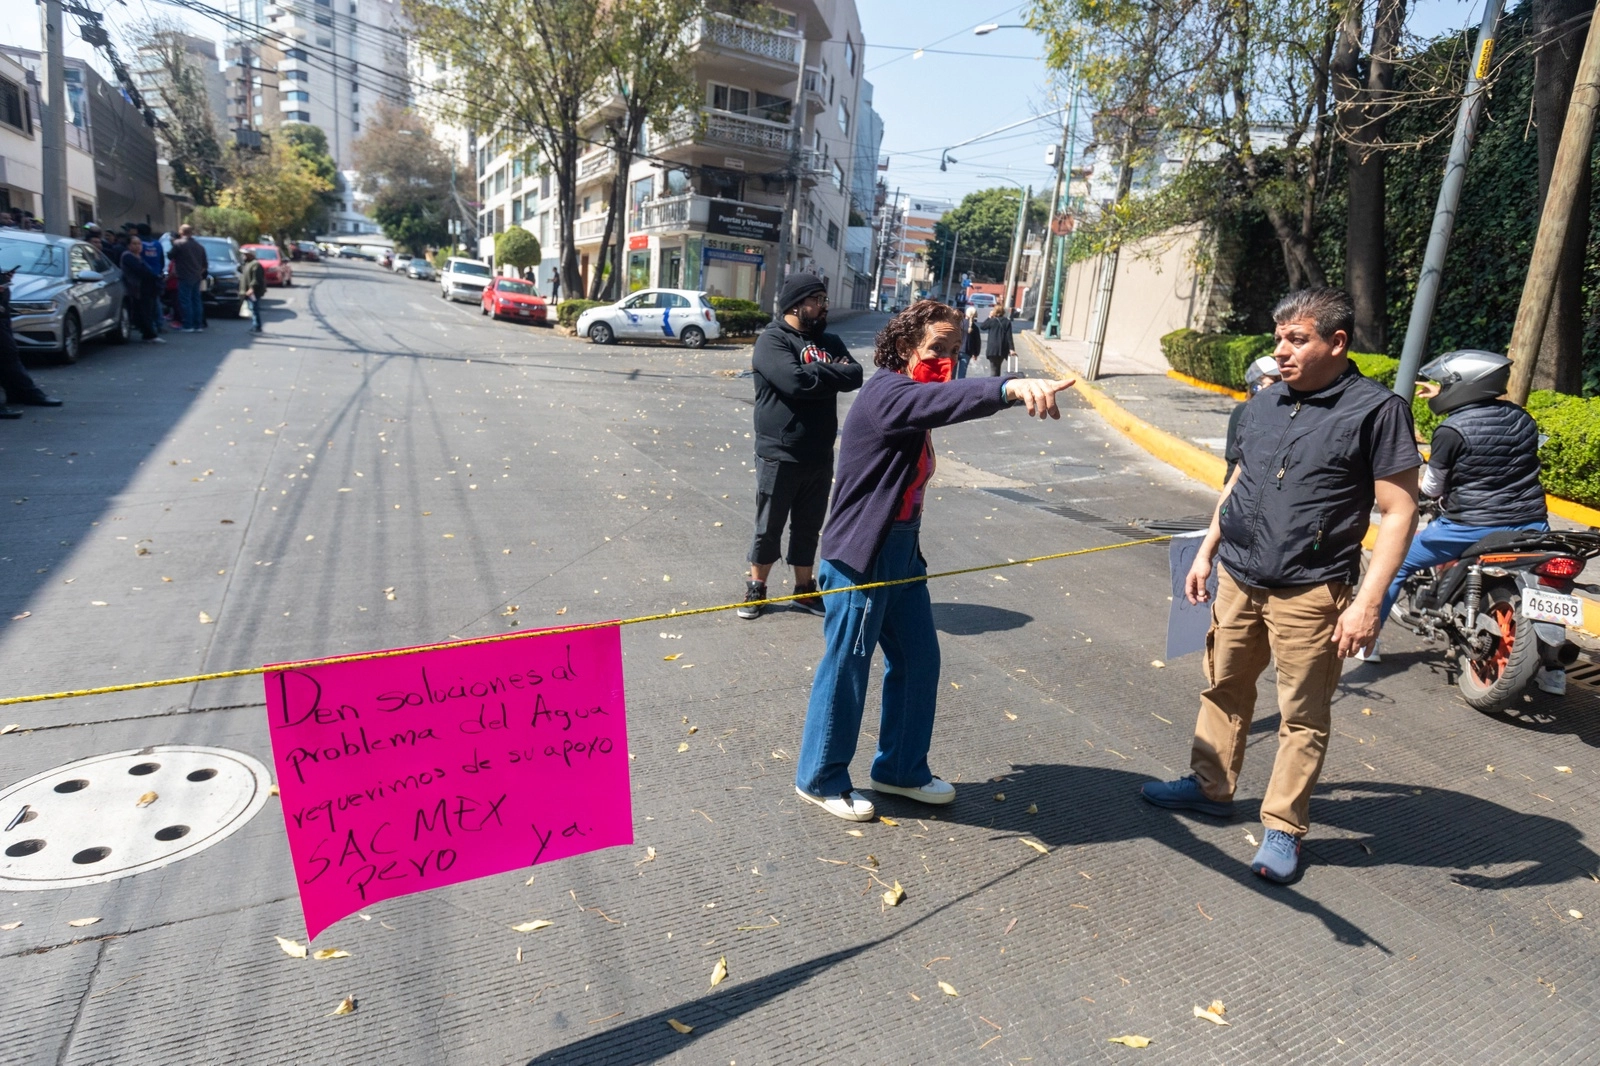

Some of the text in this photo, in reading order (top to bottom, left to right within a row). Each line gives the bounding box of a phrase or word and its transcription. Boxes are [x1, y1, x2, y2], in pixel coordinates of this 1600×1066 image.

[708, 239, 717, 248] 55
[719, 214, 742, 224] Puertas
[747, 218, 774, 229] Ventanas
[1529, 597, 1578, 617] 4636B9
[273, 644, 577, 729] Den soluciones al
[285, 693, 609, 785] problema del Agua
[292, 767, 446, 832] requerimos
[462, 748, 493, 774] de
